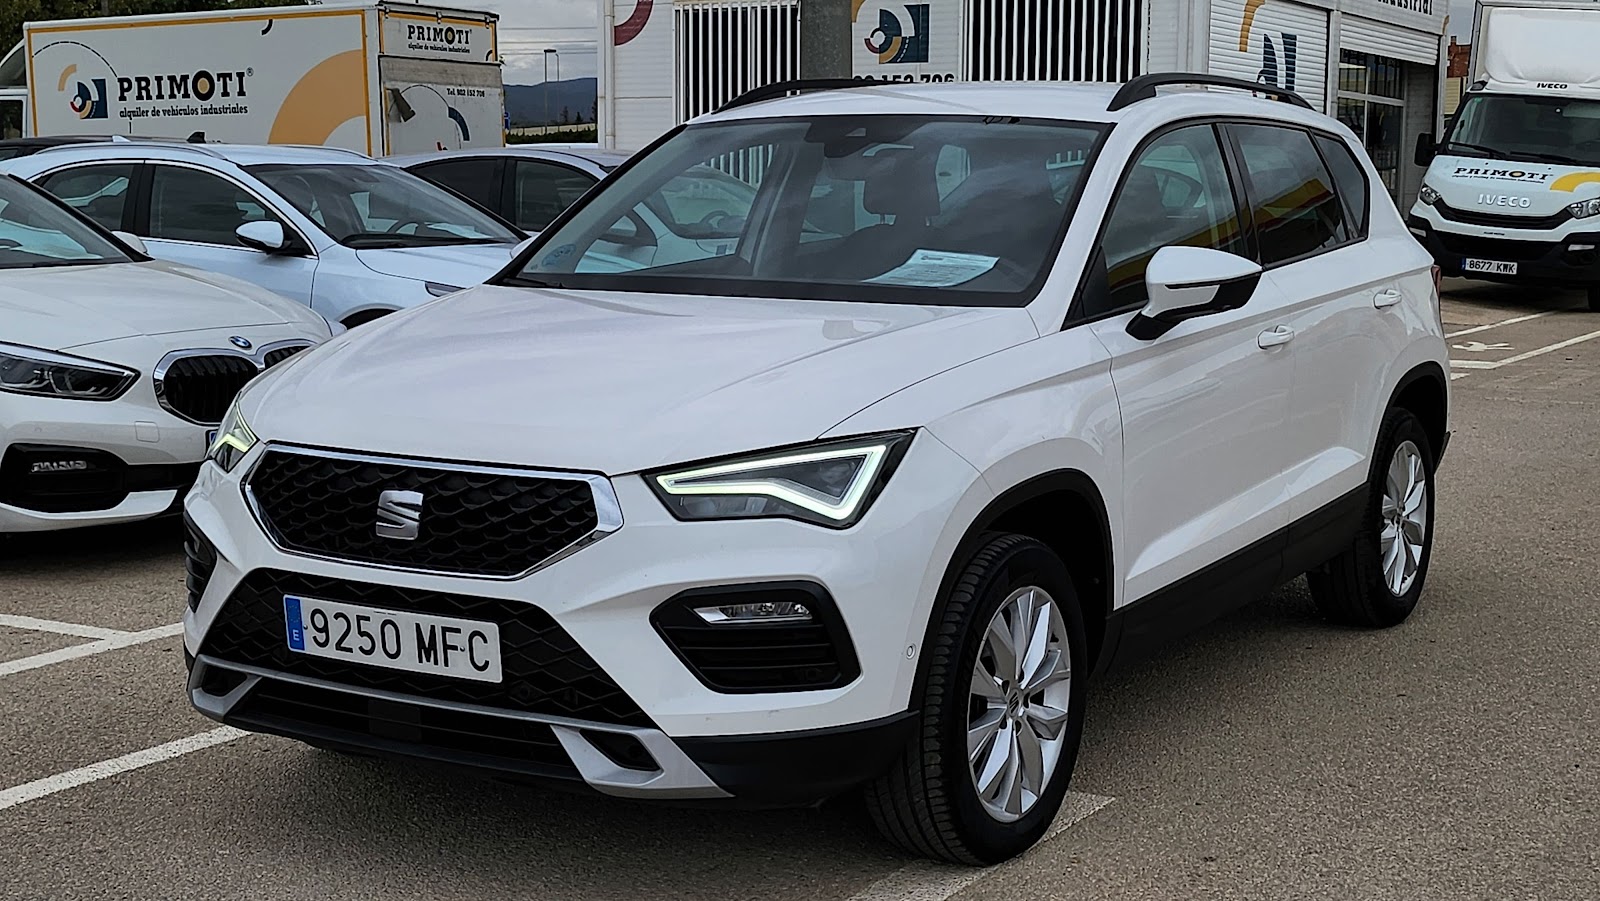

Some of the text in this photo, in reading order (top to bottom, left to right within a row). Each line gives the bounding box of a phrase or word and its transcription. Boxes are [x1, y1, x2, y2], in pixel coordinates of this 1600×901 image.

[407, 25, 470, 45] PRIMOTI
[467, 89, 475, 97] 152
[119, 106, 149, 120] alquiler
[151, 106, 161, 117] de
[200, 103, 248, 115] industriales
[1454, 167, 1550, 180] PRIMOTI
[1477, 193, 1532, 208] IVECO
[1469, 260, 1493, 271] 8677
[1496, 262, 1515, 273] KWK
[292, 608, 490, 672] E 9250 MFC
